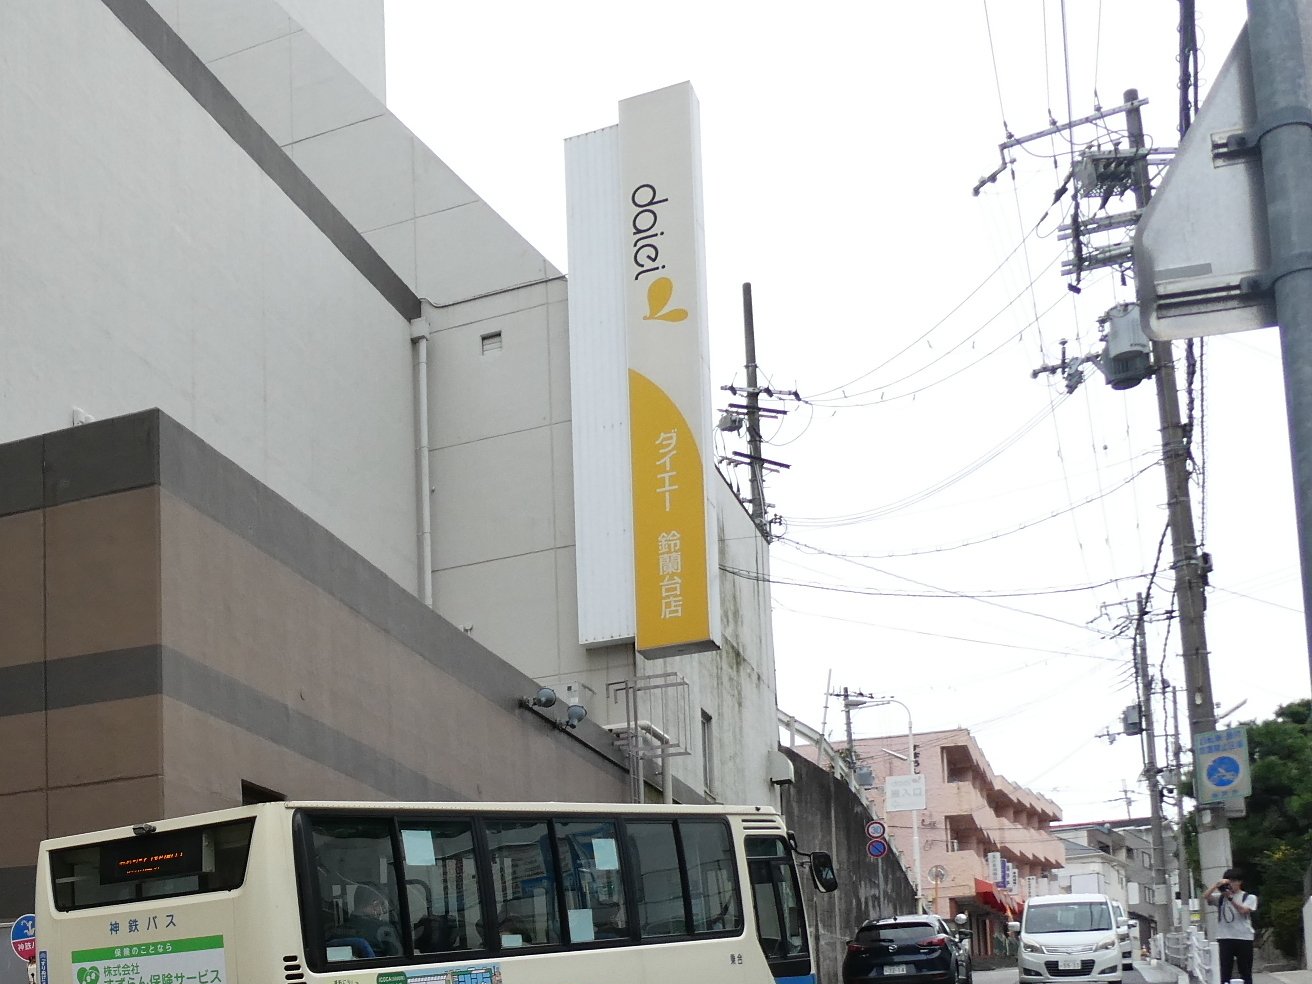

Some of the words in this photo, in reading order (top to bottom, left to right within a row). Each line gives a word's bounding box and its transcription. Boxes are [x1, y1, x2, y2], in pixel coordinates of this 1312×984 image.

[631, 183, 669, 281] daiei
[655, 428, 679, 512] ダイエー
[657, 530, 683, 619] 鈴蘭台店
[870, 825, 882, 835] 30
[109, 914, 177, 935] 神鉄バス
[114, 943, 173, 957] 保険のことなら
[103, 963, 140, 977] 株式会社
